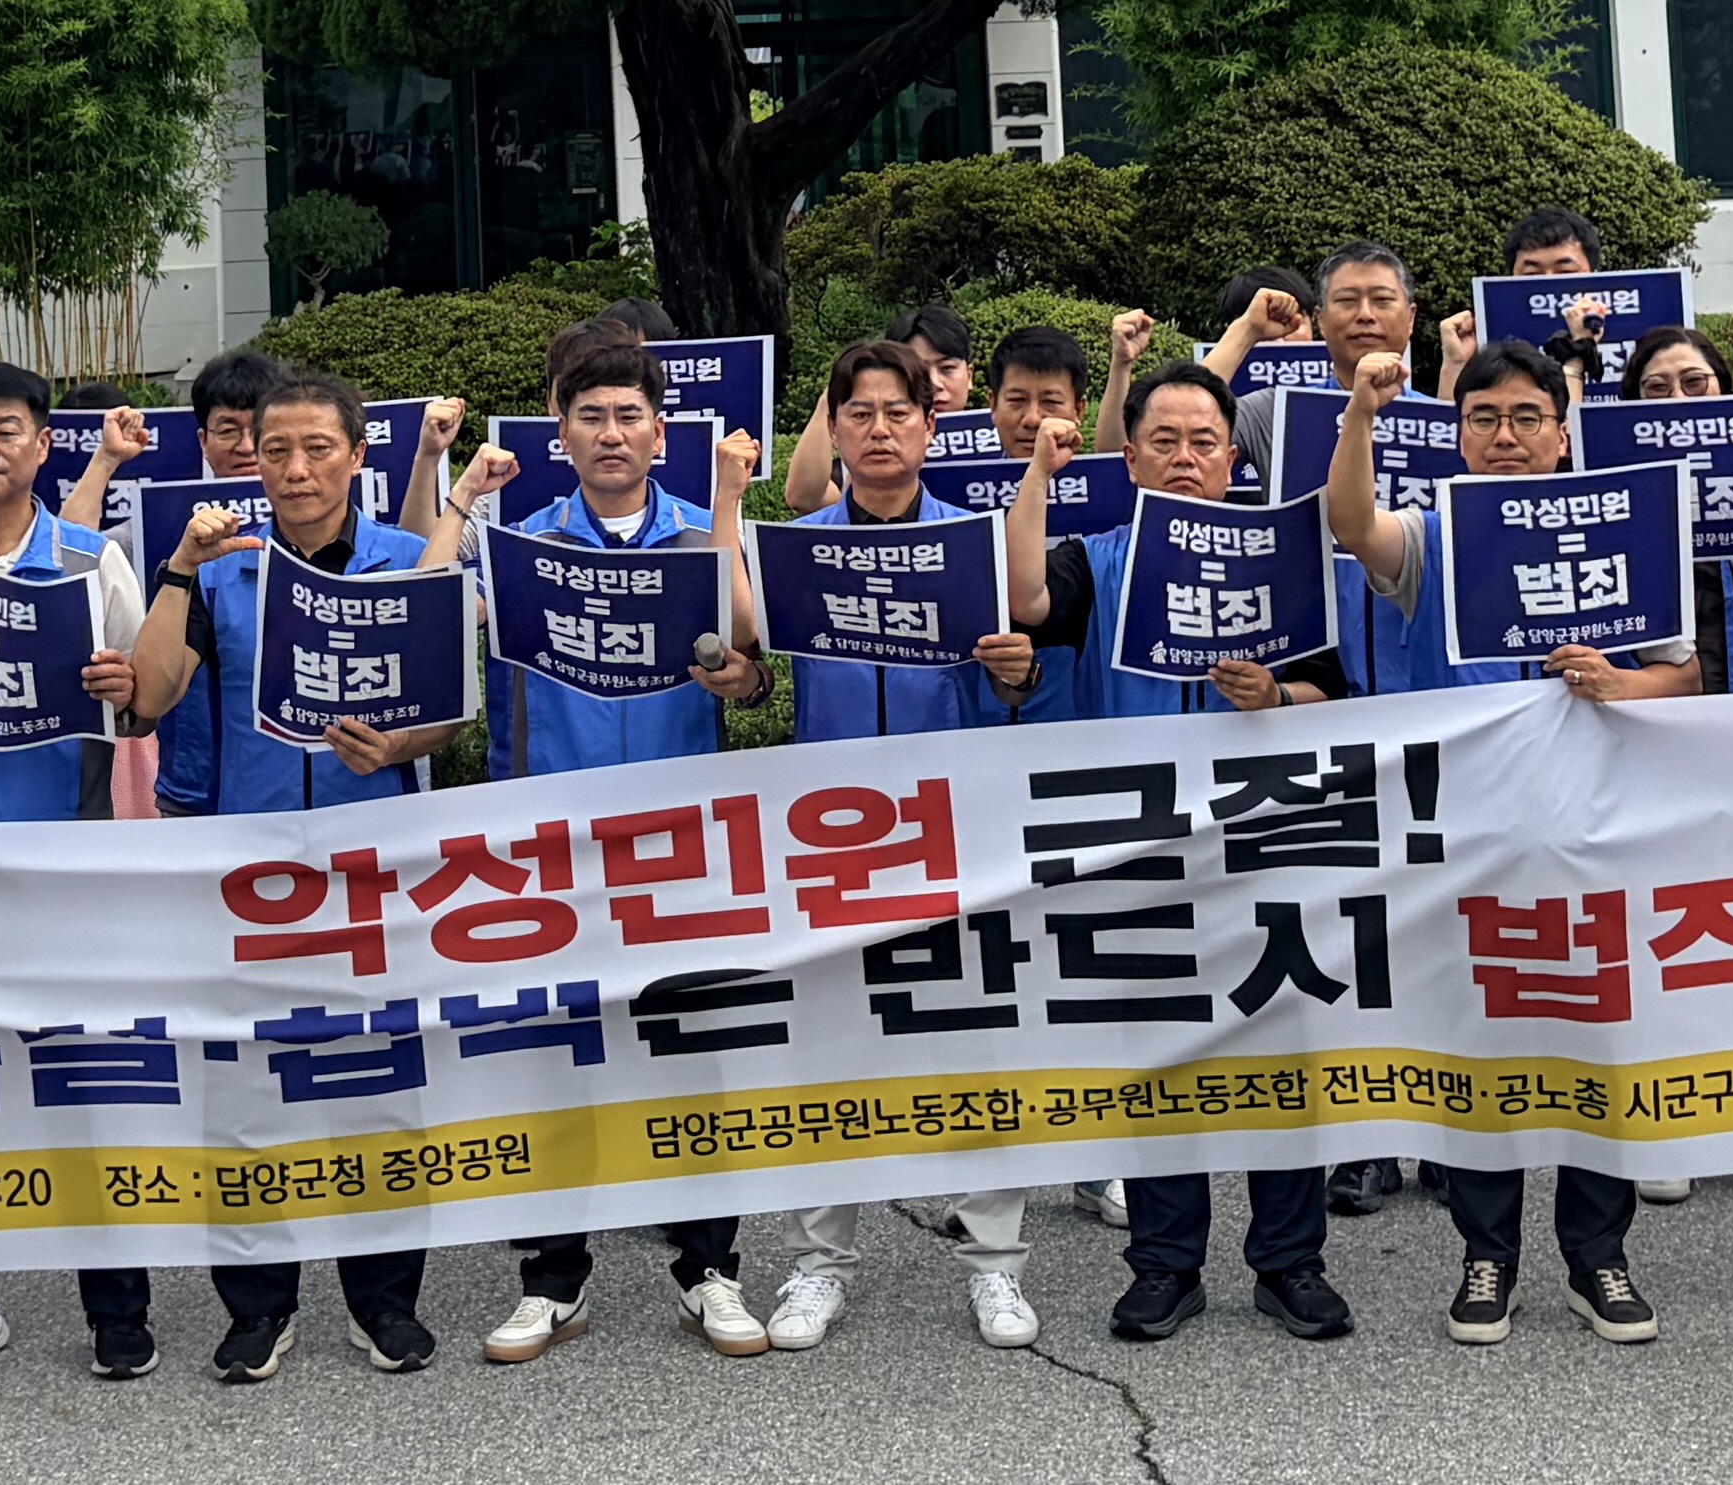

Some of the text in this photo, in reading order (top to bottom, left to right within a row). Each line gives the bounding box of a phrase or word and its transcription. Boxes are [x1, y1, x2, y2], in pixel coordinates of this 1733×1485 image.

[665, 357, 722, 383] 민원
[1248, 360, 1333, 386] 악성민
[927, 427, 1002, 458] 성민원
[1336, 412, 1459, 450] 성민원
[1501, 489, 1632, 530] 악성민원
[811, 543, 945, 574] 악성민원
[1169, 518, 1277, 557] 악성민원
[535, 557, 663, 596] 악성민원
[1513, 553, 1630, 617] 범죄
[291, 582, 410, 627] 악성민원
[822, 592, 940, 643] 범죄
[1166, 582, 1274, 638] 범죄
[544, 608, 656, 668] 범죄
[1528, 614, 1647, 646] 담양군공무원노동조합
[292, 644, 404, 703] 범죄
[220, 741, 1445, 977] 악성민원 근절!
[863, 895, 1394, 1036] 반드시
[646, 1068, 1309, 1160] 담양군공무원노동조합·공무원노동조합
[1321, 1062, 1610, 1120] 전남연맹·공노총
[105, 1132, 533, 1208] 장소 : 담양군청 중앙공원
